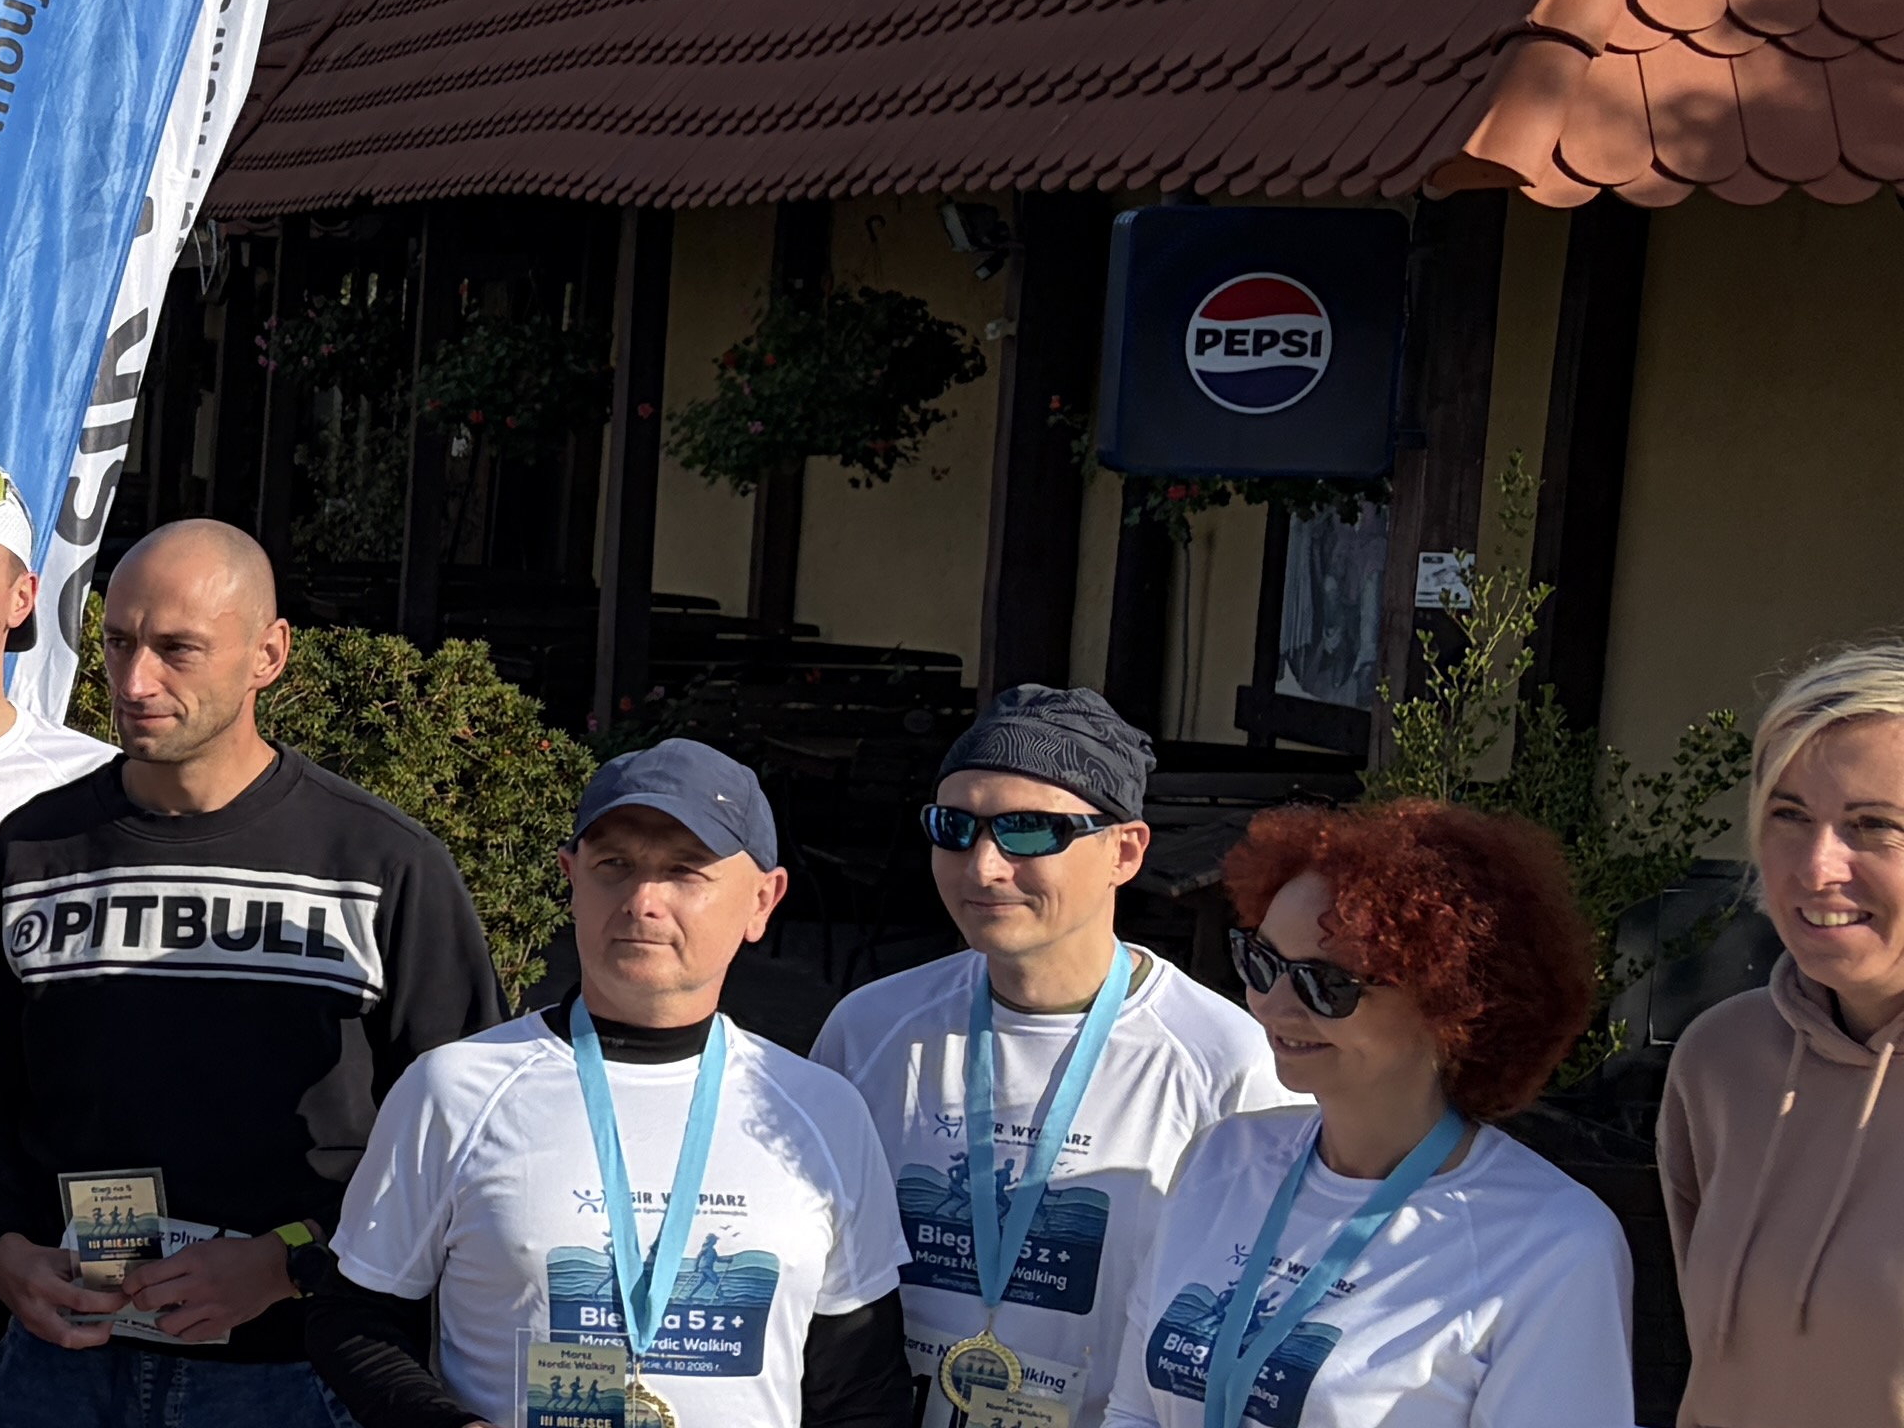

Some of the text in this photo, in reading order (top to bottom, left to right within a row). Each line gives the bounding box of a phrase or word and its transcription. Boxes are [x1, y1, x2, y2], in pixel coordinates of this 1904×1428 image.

[1194, 326, 1324, 359] PEPSI
[102, 1237, 151, 1249] MIEJSCE
[918, 1223, 971, 1256] Bieg
[1036, 1245, 1050, 1263] z
[914, 1249, 957, 1270] Marsz
[688, 1310, 706, 1330] 5
[712, 1315, 726, 1331] z
[560, 1349, 592, 1361] Marsz
[684, 1338, 742, 1355] Walking
[1163, 1332, 1271, 1380] Bieg z
[538, 1359, 616, 1374] Nordic Walking
[1157, 1355, 1191, 1377] Marsz
[549, 1415, 564, 1427] III
